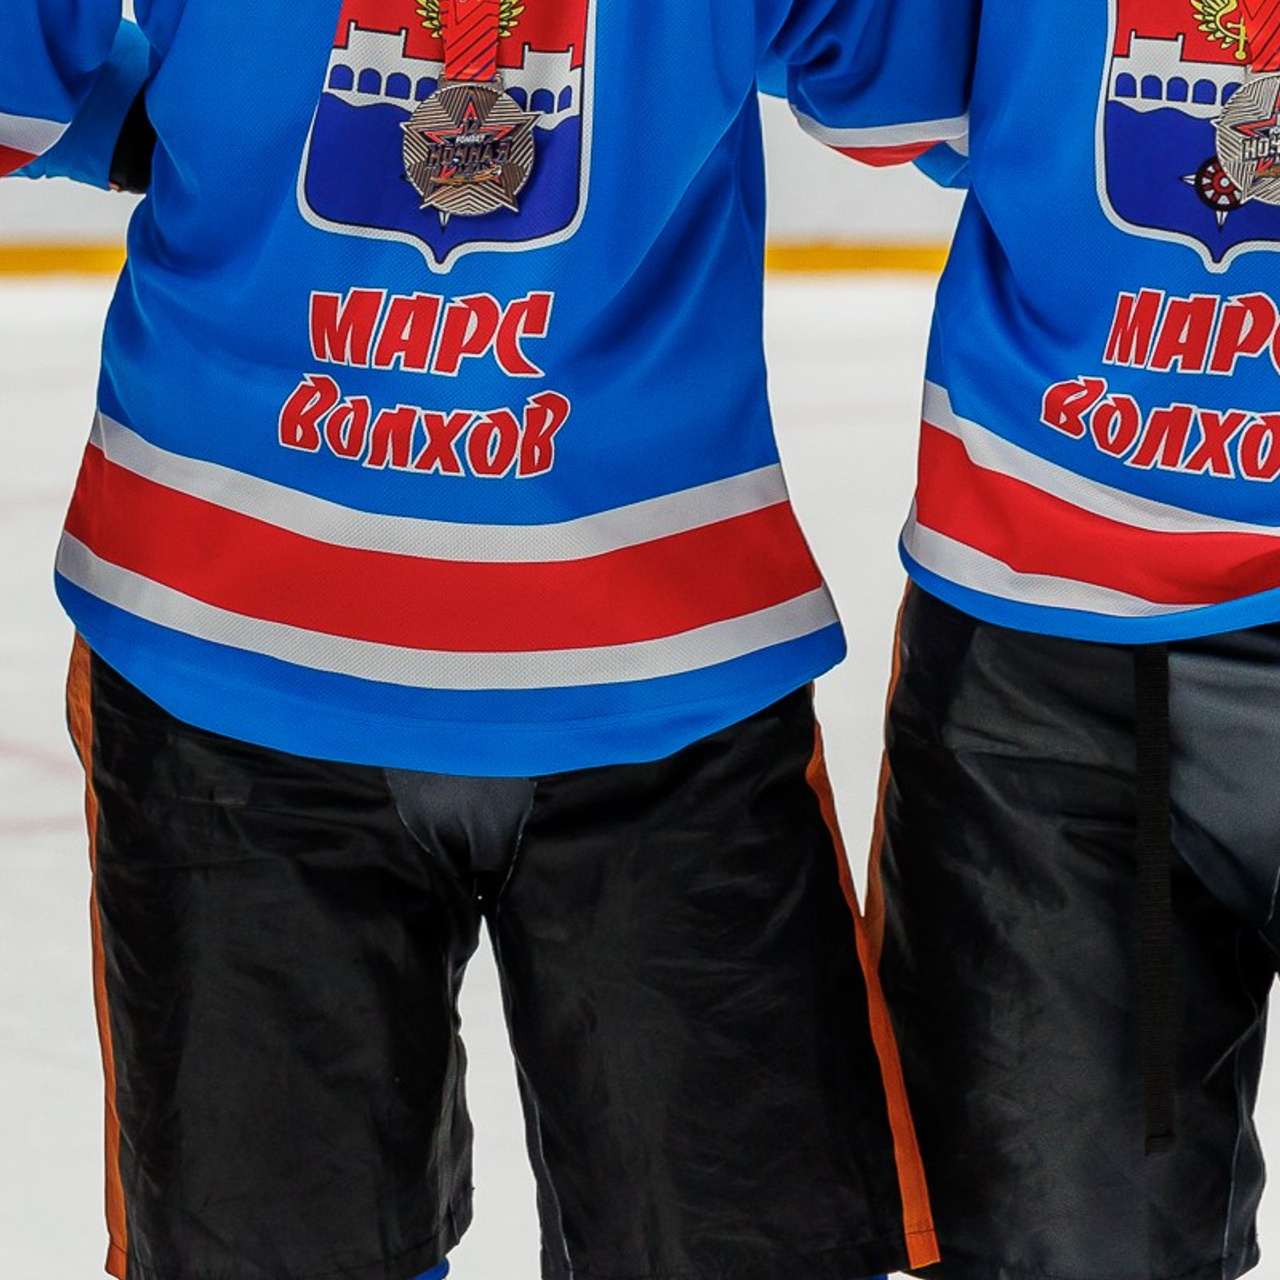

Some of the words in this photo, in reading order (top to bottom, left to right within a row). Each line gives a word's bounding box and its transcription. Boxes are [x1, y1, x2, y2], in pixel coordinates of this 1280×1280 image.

[309, 287, 554, 377] МАРС
[1102, 287, 1280, 377] МАР
[278, 373, 571, 479] ВОЛХОВ
[1040, 375, 1280, 483] ВОЛХО
